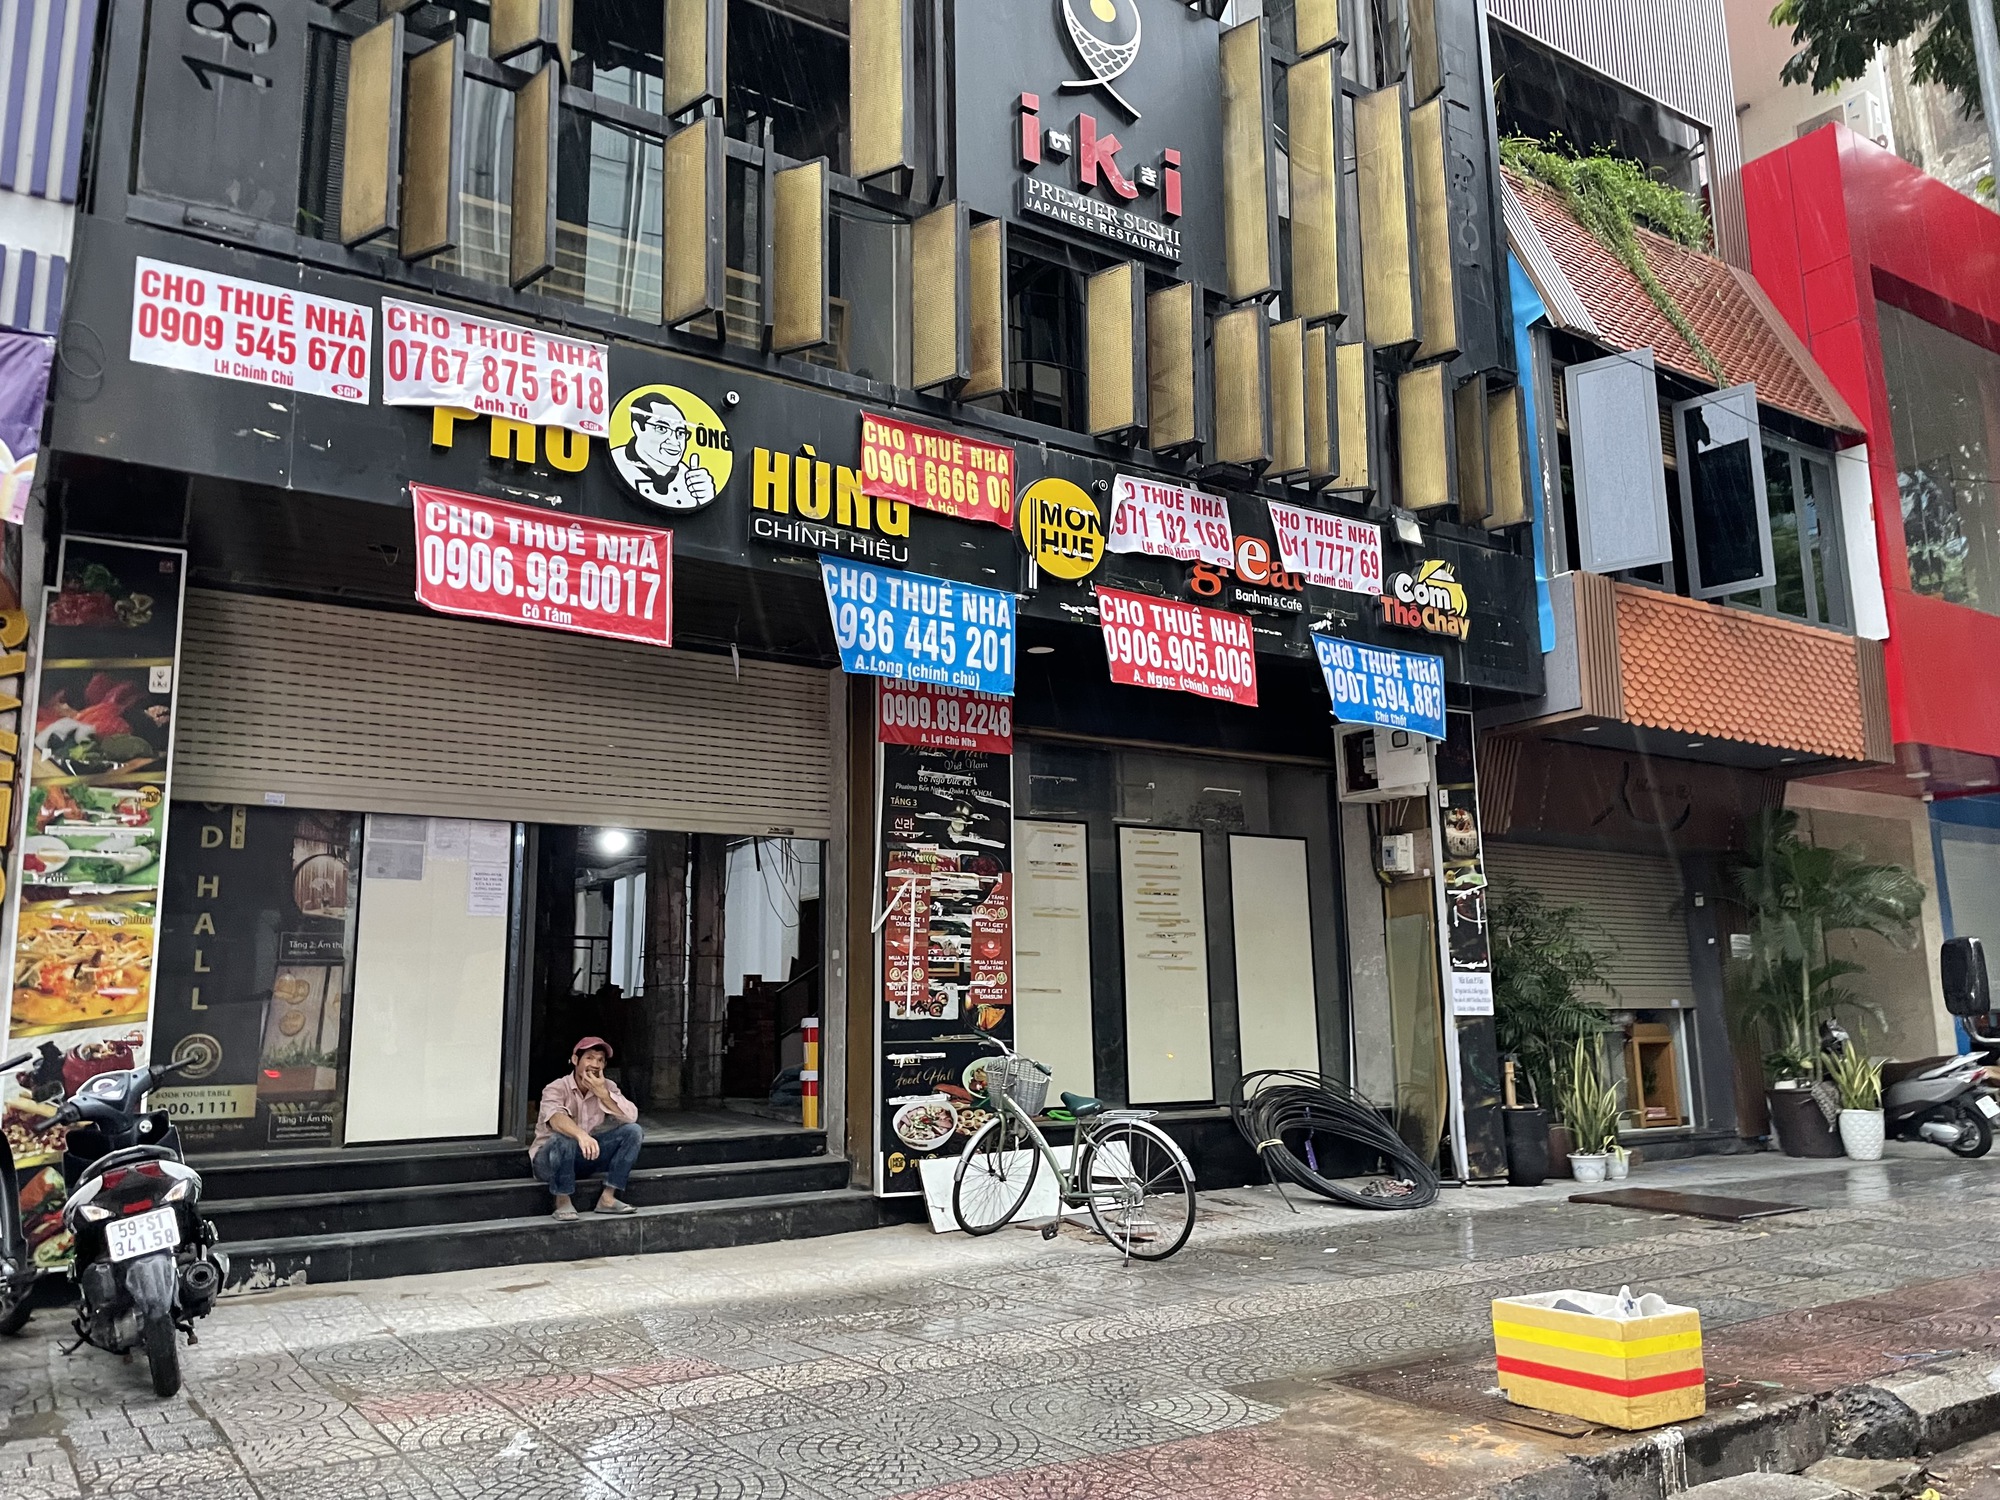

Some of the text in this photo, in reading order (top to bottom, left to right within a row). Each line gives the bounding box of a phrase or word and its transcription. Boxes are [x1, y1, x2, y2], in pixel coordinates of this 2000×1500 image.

[1026, 197, 1181, 259] JAPANESE RESTAURANT
[1027, 176, 1181, 247] PREMIER SUSHI
[141, 269, 366, 341] CHO THUÊ NHÀ
[138, 303, 366, 379] 0909 545 670
[388, 307, 603, 372] CHO THUÊ NHÀ
[214, 358, 294, 387] LH Chính Chủ
[336, 385, 358, 399] SGH
[389, 339, 604, 415] 0767 875 618
[474, 395, 528, 420] Anh Tú
[863, 421, 1009, 476] CHO THUÊ NHÀ
[696, 422, 731, 451] ÔNG
[753, 443, 910, 538] HÙNG
[863, 446, 1010, 514] 0901 6666 06
[1140, 485, 1185, 512] THUÊ
[1190, 495, 1226, 520] NHÀ
[926, 498, 959, 516] A Hải
[1041, 499, 1102, 535] MON
[1111, 503, 1230, 552] 971 132 168
[425, 501, 660, 570] CHO THUÊ NHÀ
[755, 517, 908, 564] CHÍNH HIỆU
[1142, 540, 1154, 553] LH
[1175, 543, 1201, 560] Hùng
[1305, 516, 1343, 540] THUÊ
[1348, 525, 1378, 546] NHÀ
[423, 535, 661, 621] 0906.98.0017
[1313, 574, 1336, 587] chính
[1338, 576, 1353, 590] chủ
[1315, 540, 1354, 575] 7777
[1360, 549, 1379, 580] 69
[522, 602, 572, 624] Cô Tám
[823, 563, 1012, 630] CHO THUÊ NHÀ
[1280, 597, 1303, 611] Cafe
[1394, 572, 1451, 610] Cơm
[833, 602, 1011, 675] 936 445 201
[1099, 594, 1251, 649] CHO THUÊ NHÀ
[855, 654, 980, 690] A.Long (chính chủ)
[1103, 624, 1252, 687] 0906.905.006
[1317, 641, 1441, 686] CHO THUÊ NHÀ
[1133, 670, 1234, 702] A. Ngọc (chính chủ)
[1323, 667, 1441, 721] 0907.594.883
[882, 693, 1011, 738] 0909.89.2248
[921, 733, 929, 743] A.
[961, 737, 977, 748] Nhà
[912, 799, 918, 807] 3
[115, 1228, 174, 1256] 341.58
[118, 1213, 163, 1238] 59-S1
